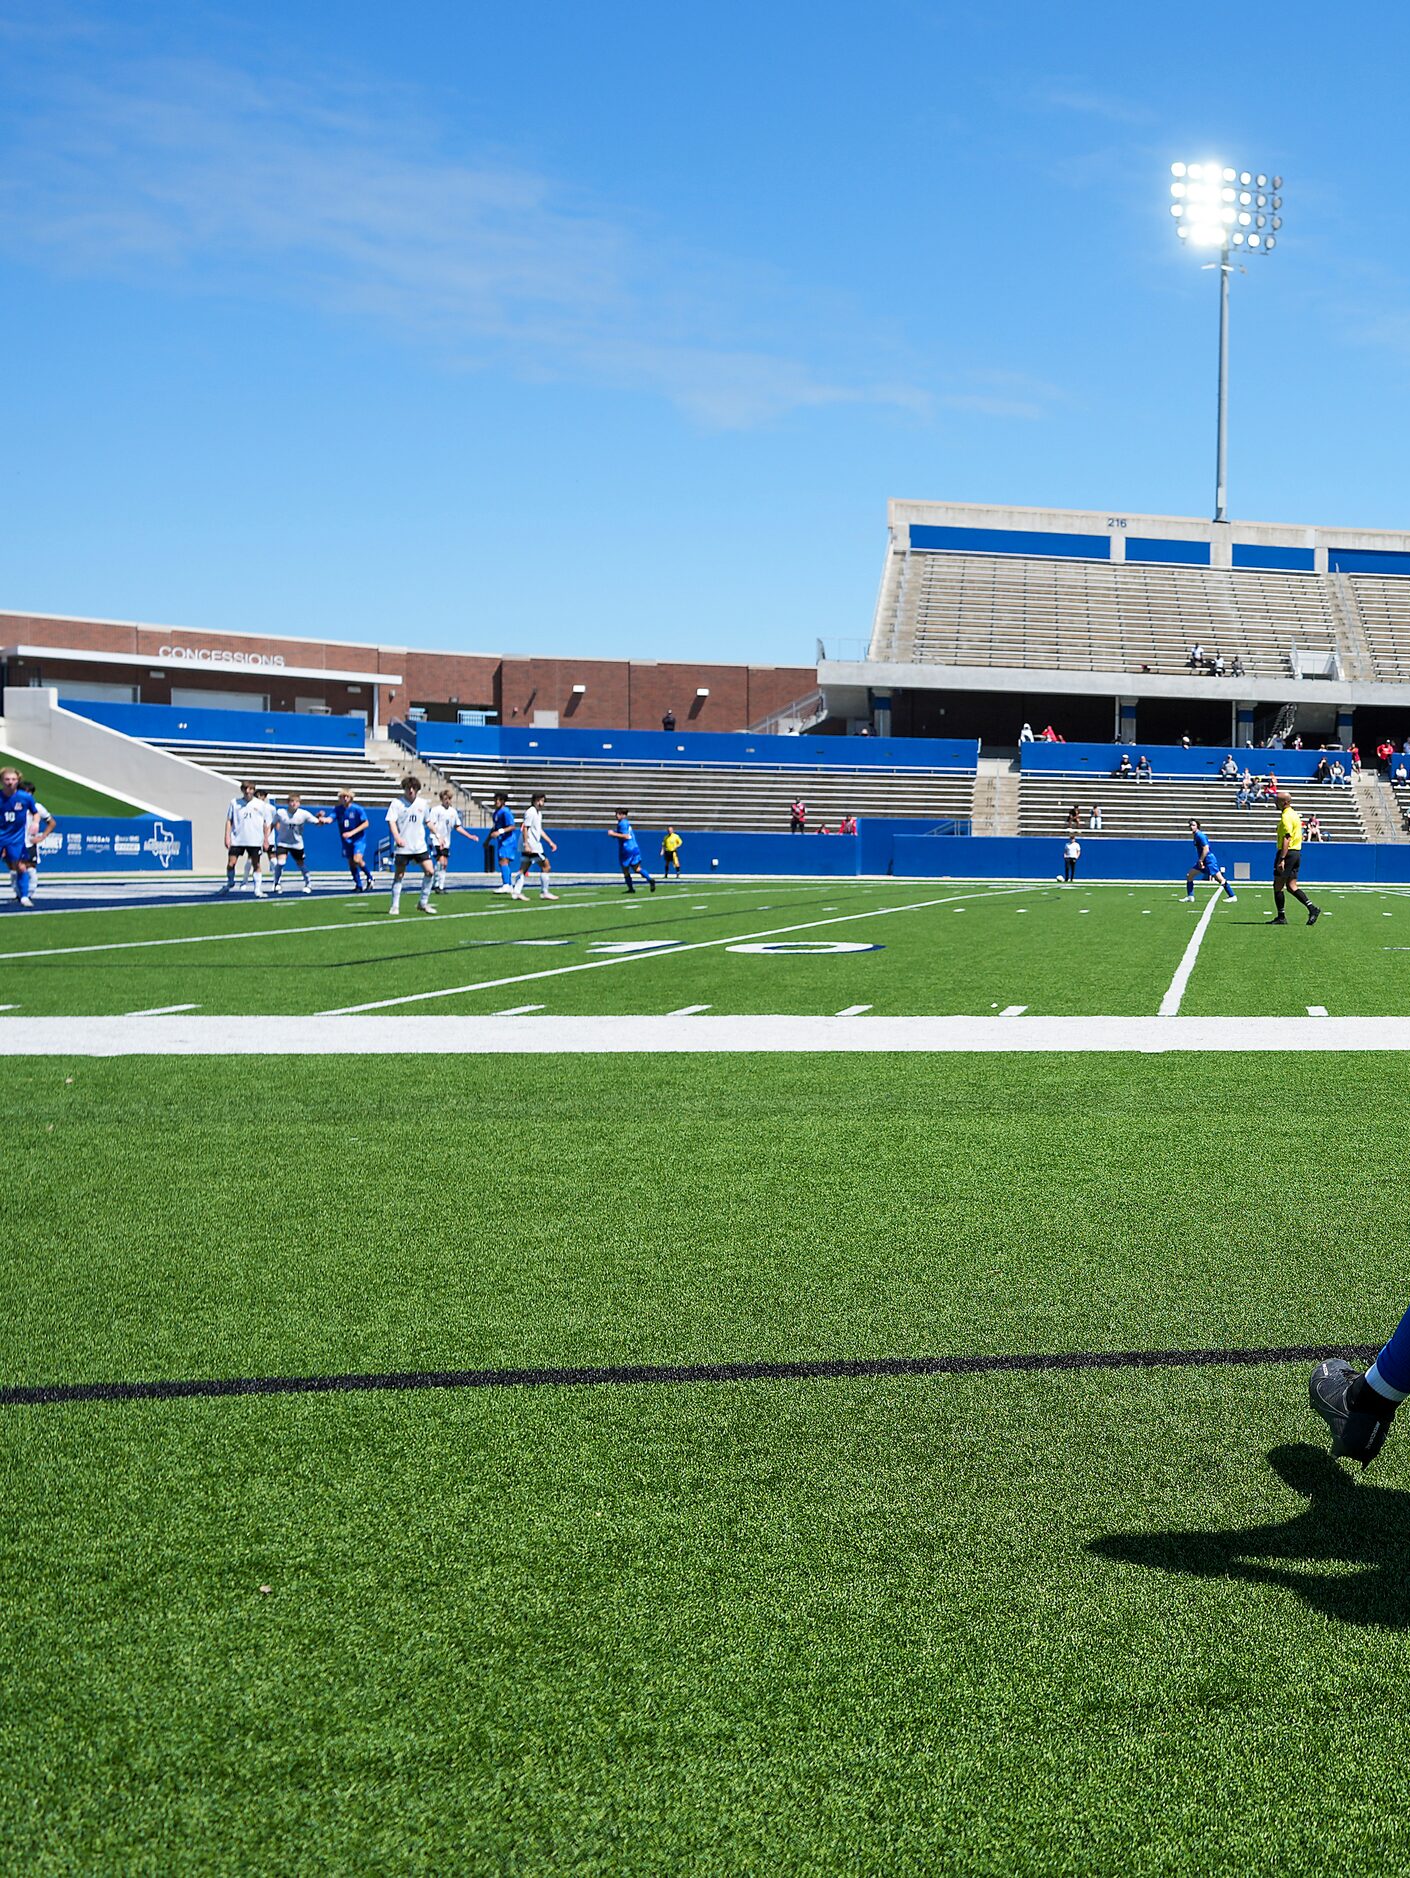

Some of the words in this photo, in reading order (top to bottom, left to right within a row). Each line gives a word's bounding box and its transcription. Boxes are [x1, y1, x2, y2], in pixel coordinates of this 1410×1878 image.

[1107, 517, 1127, 528] 216
[158, 645, 284, 668] CONCESSIONS
[586, 940, 883, 954] 10
